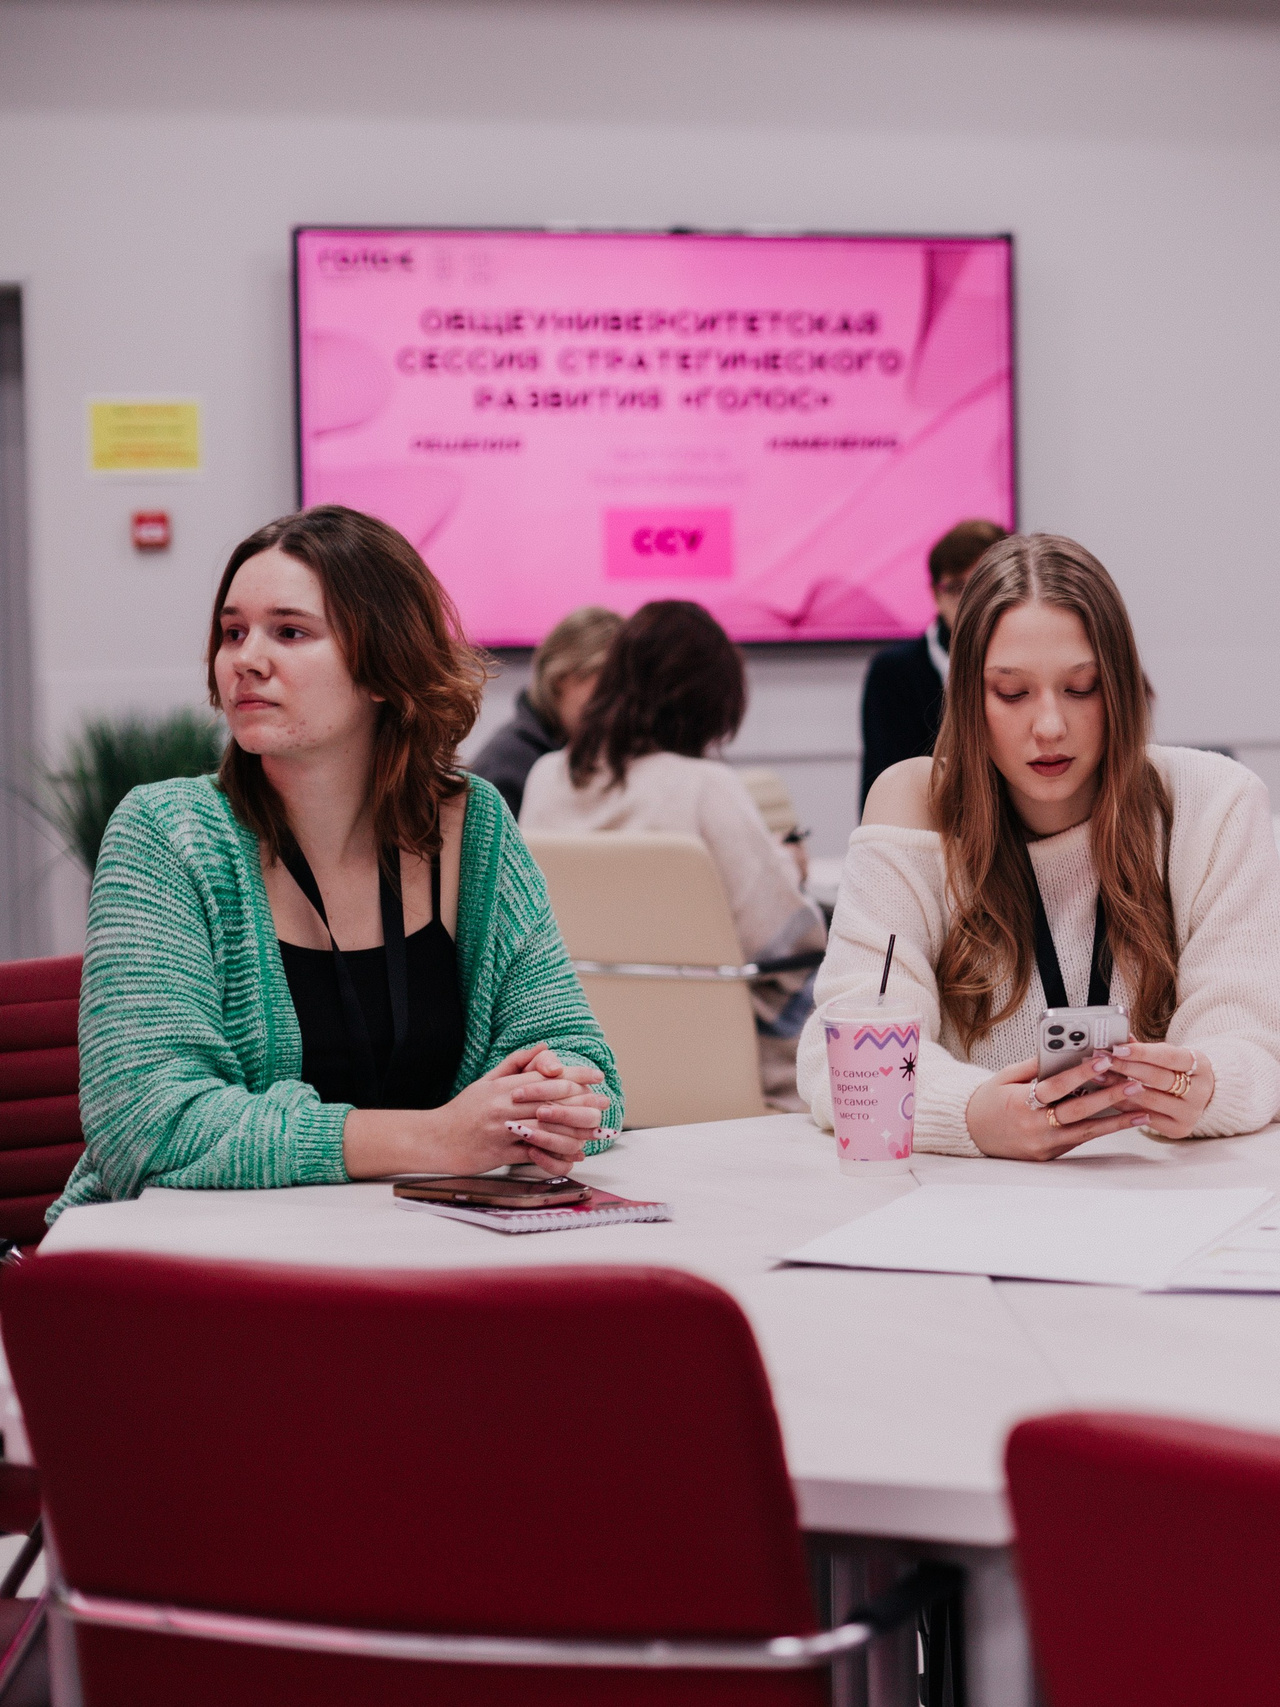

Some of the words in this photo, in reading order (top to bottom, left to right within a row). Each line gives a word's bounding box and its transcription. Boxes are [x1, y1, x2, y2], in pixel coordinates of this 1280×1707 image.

[418, 308, 882, 340] ОБЩЕУНИВЕРСИТЕТСКАЯ
[396, 346, 544, 375] СЕССИЯ
[558, 347, 903, 376] СТРАТЕГИЧЕСКОГО
[473, 386, 664, 412] РАЗВИТИЯ
[843, 1070, 880, 1078] самое
[836, 1083, 869, 1094] время
[844, 1098, 879, 1106] самое
[839, 1111, 870, 1120] место
